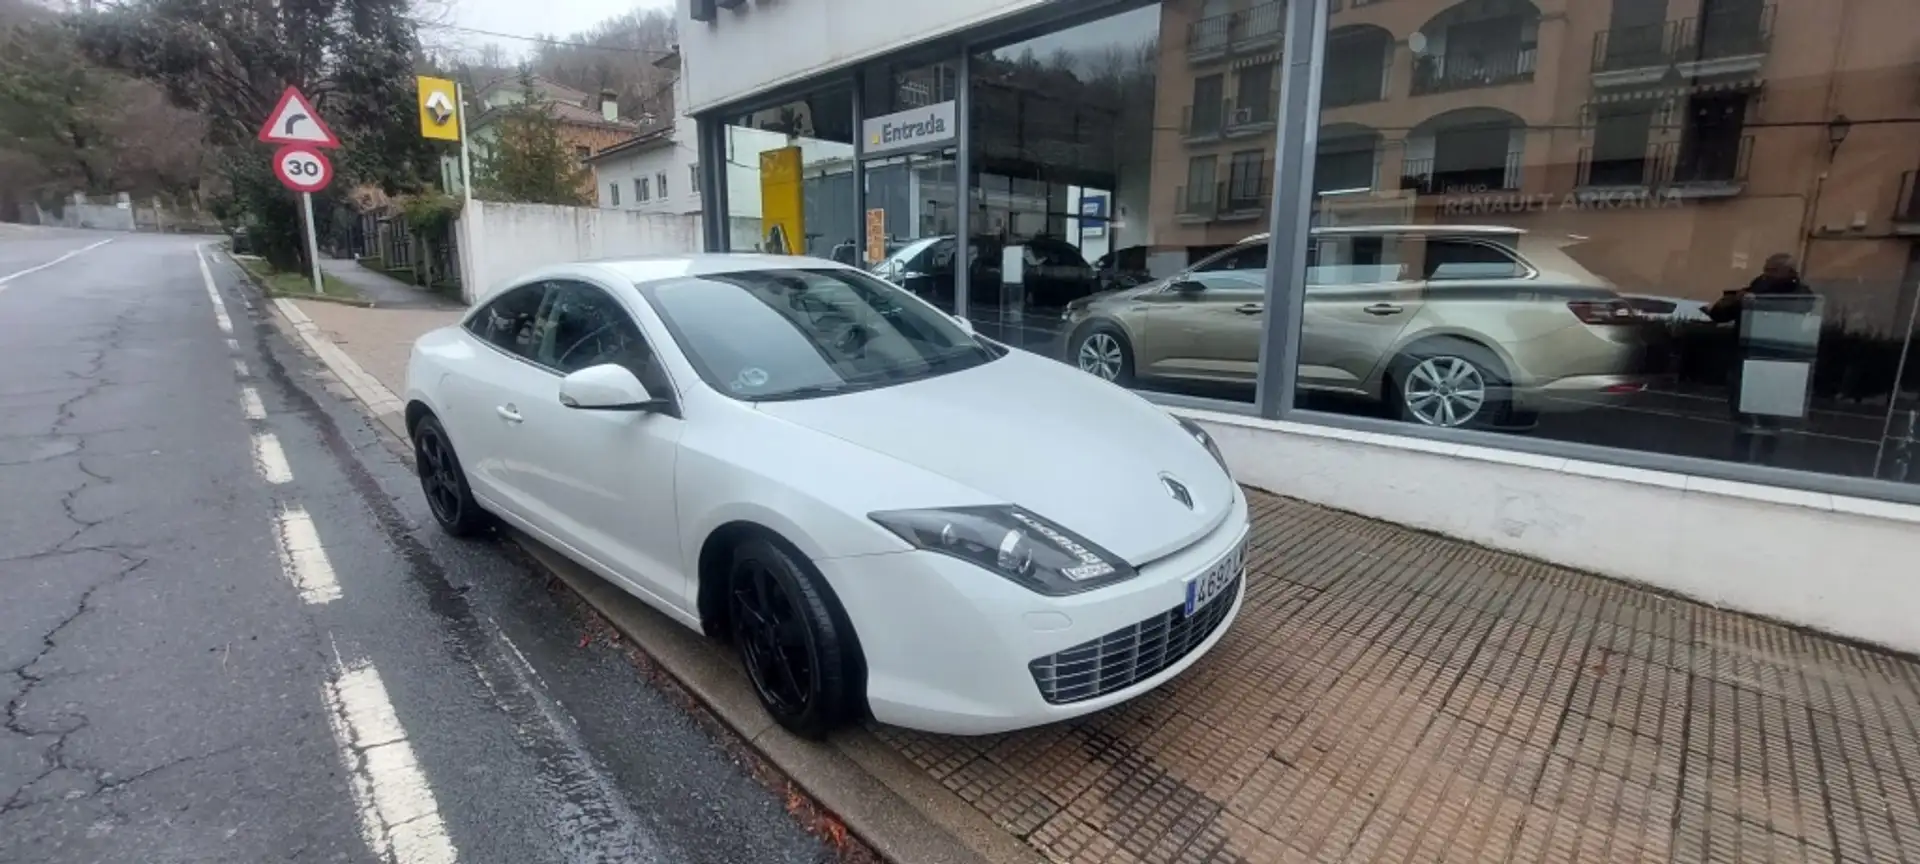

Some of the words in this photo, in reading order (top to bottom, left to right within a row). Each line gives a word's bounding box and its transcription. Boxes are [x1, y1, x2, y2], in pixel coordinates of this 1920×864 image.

[882, 113, 945, 143] Entrada
[288, 159, 318, 177] 30
[1443, 193, 1554, 215] RENAULT
[1558, 189, 1684, 212] ARKANA
